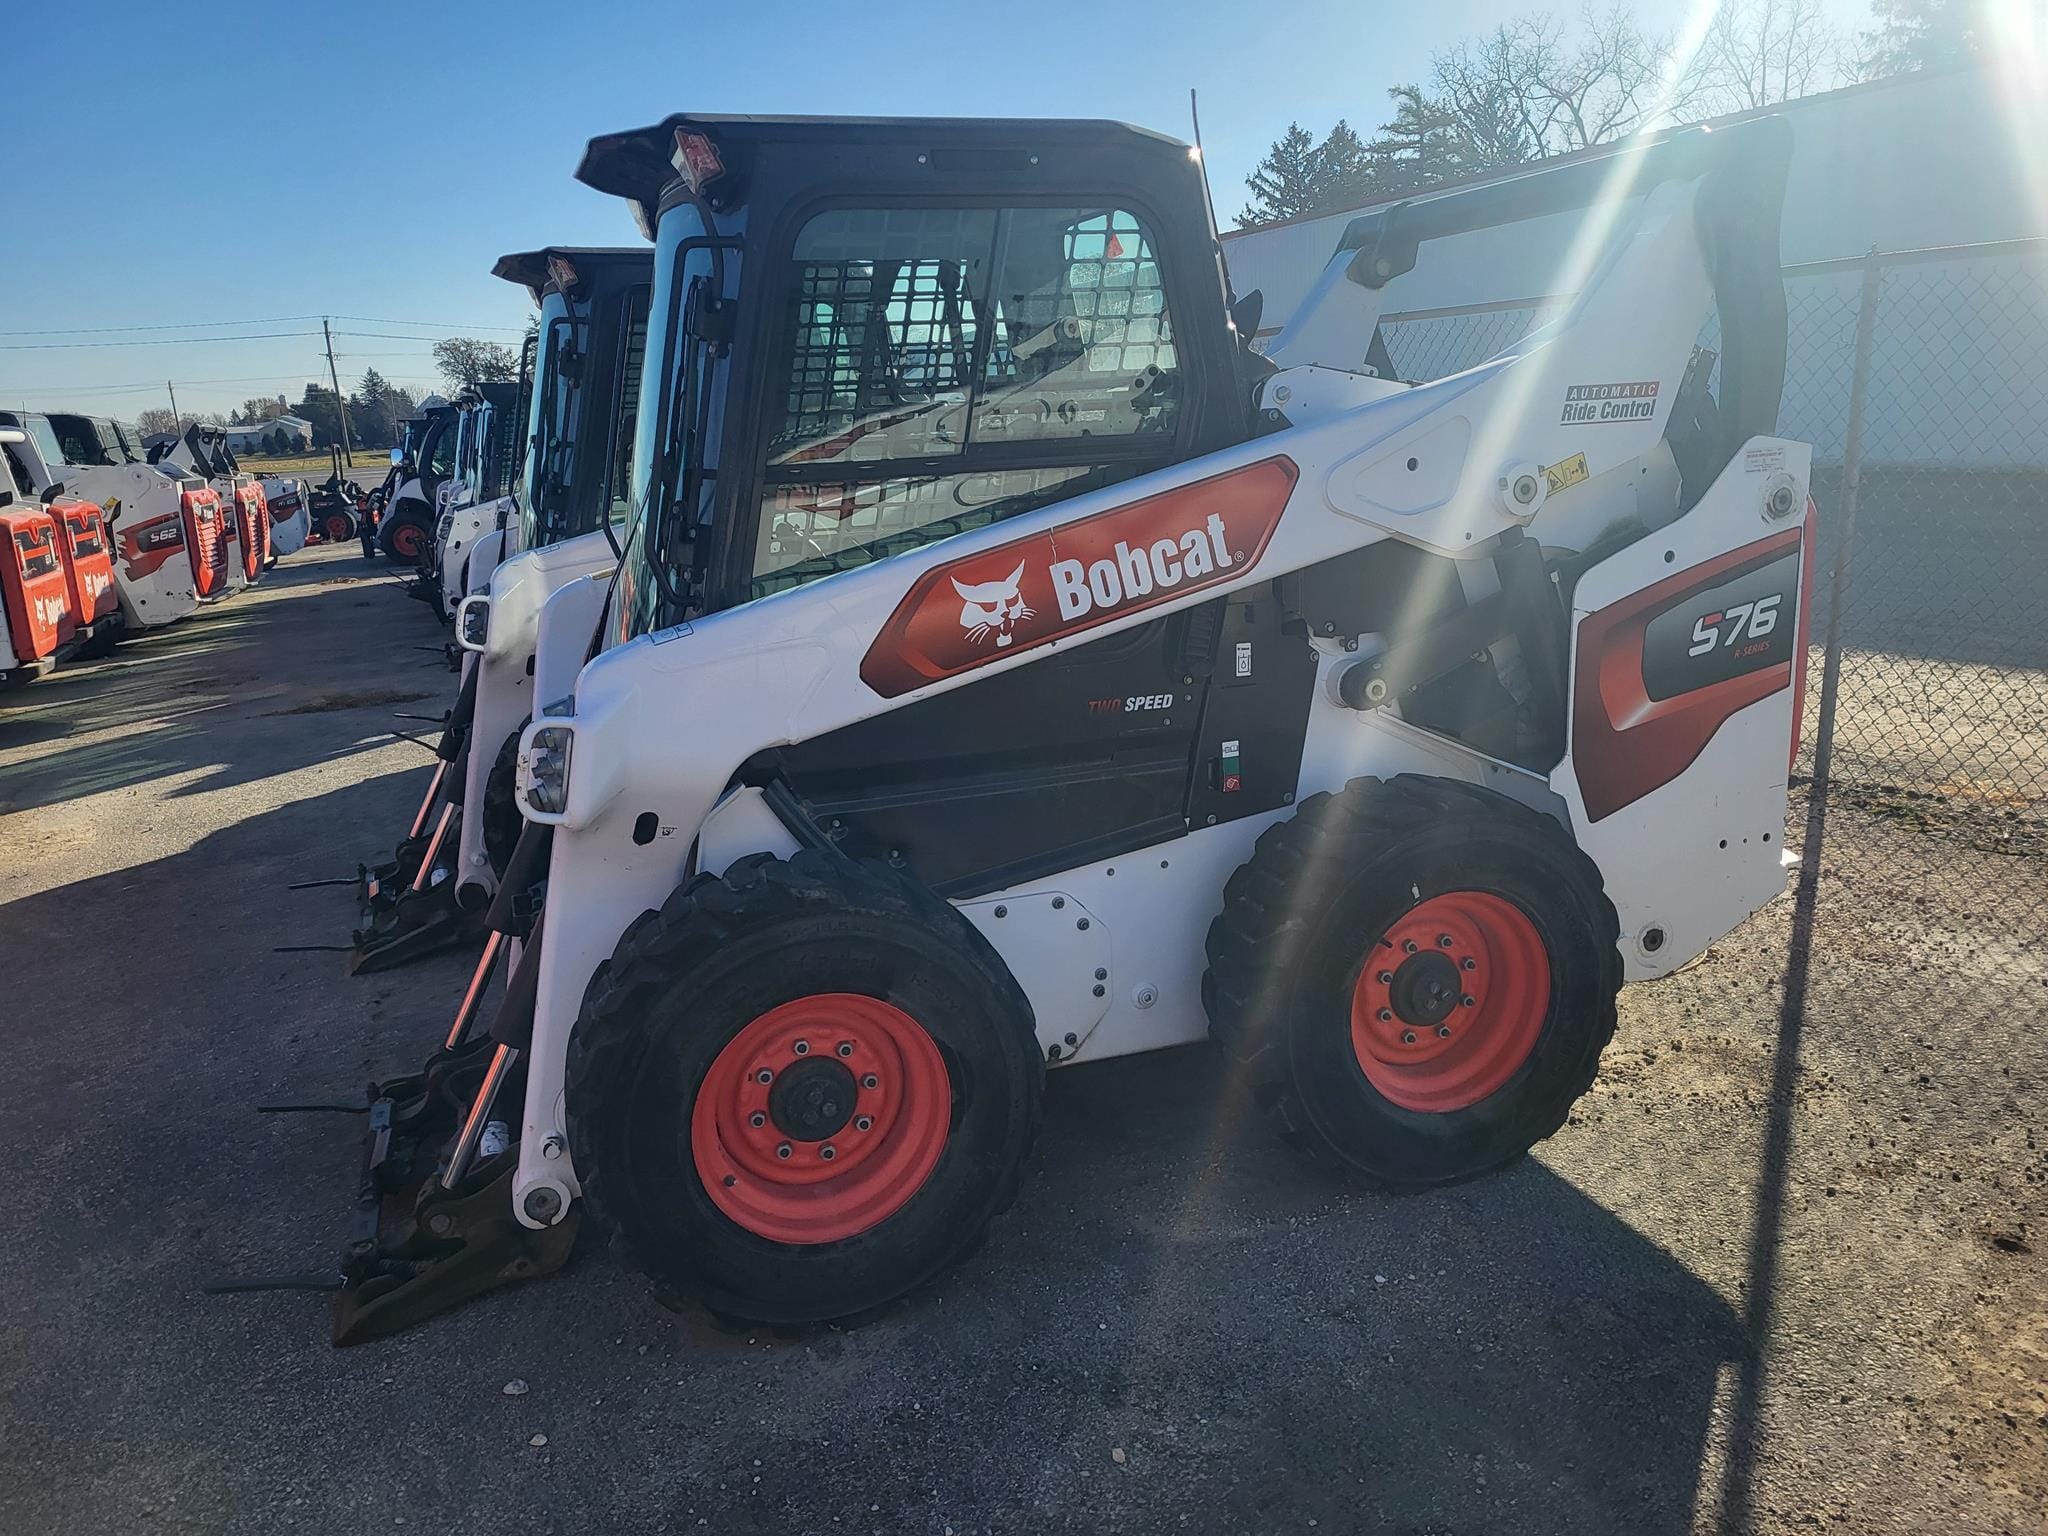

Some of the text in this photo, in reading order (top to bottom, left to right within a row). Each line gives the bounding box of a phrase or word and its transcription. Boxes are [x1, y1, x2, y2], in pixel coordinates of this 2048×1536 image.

[1569, 384, 1656, 400] AUTOMATIC
[1561, 399, 1656, 421] Ride Control
[150, 528, 177, 543] S62
[1049, 513, 1233, 622] Bobcat
[1688, 594, 1782, 657] S76
[1734, 640, 1771, 659] R-SERIES
[1088, 694, 1174, 713] TWO SPEED
